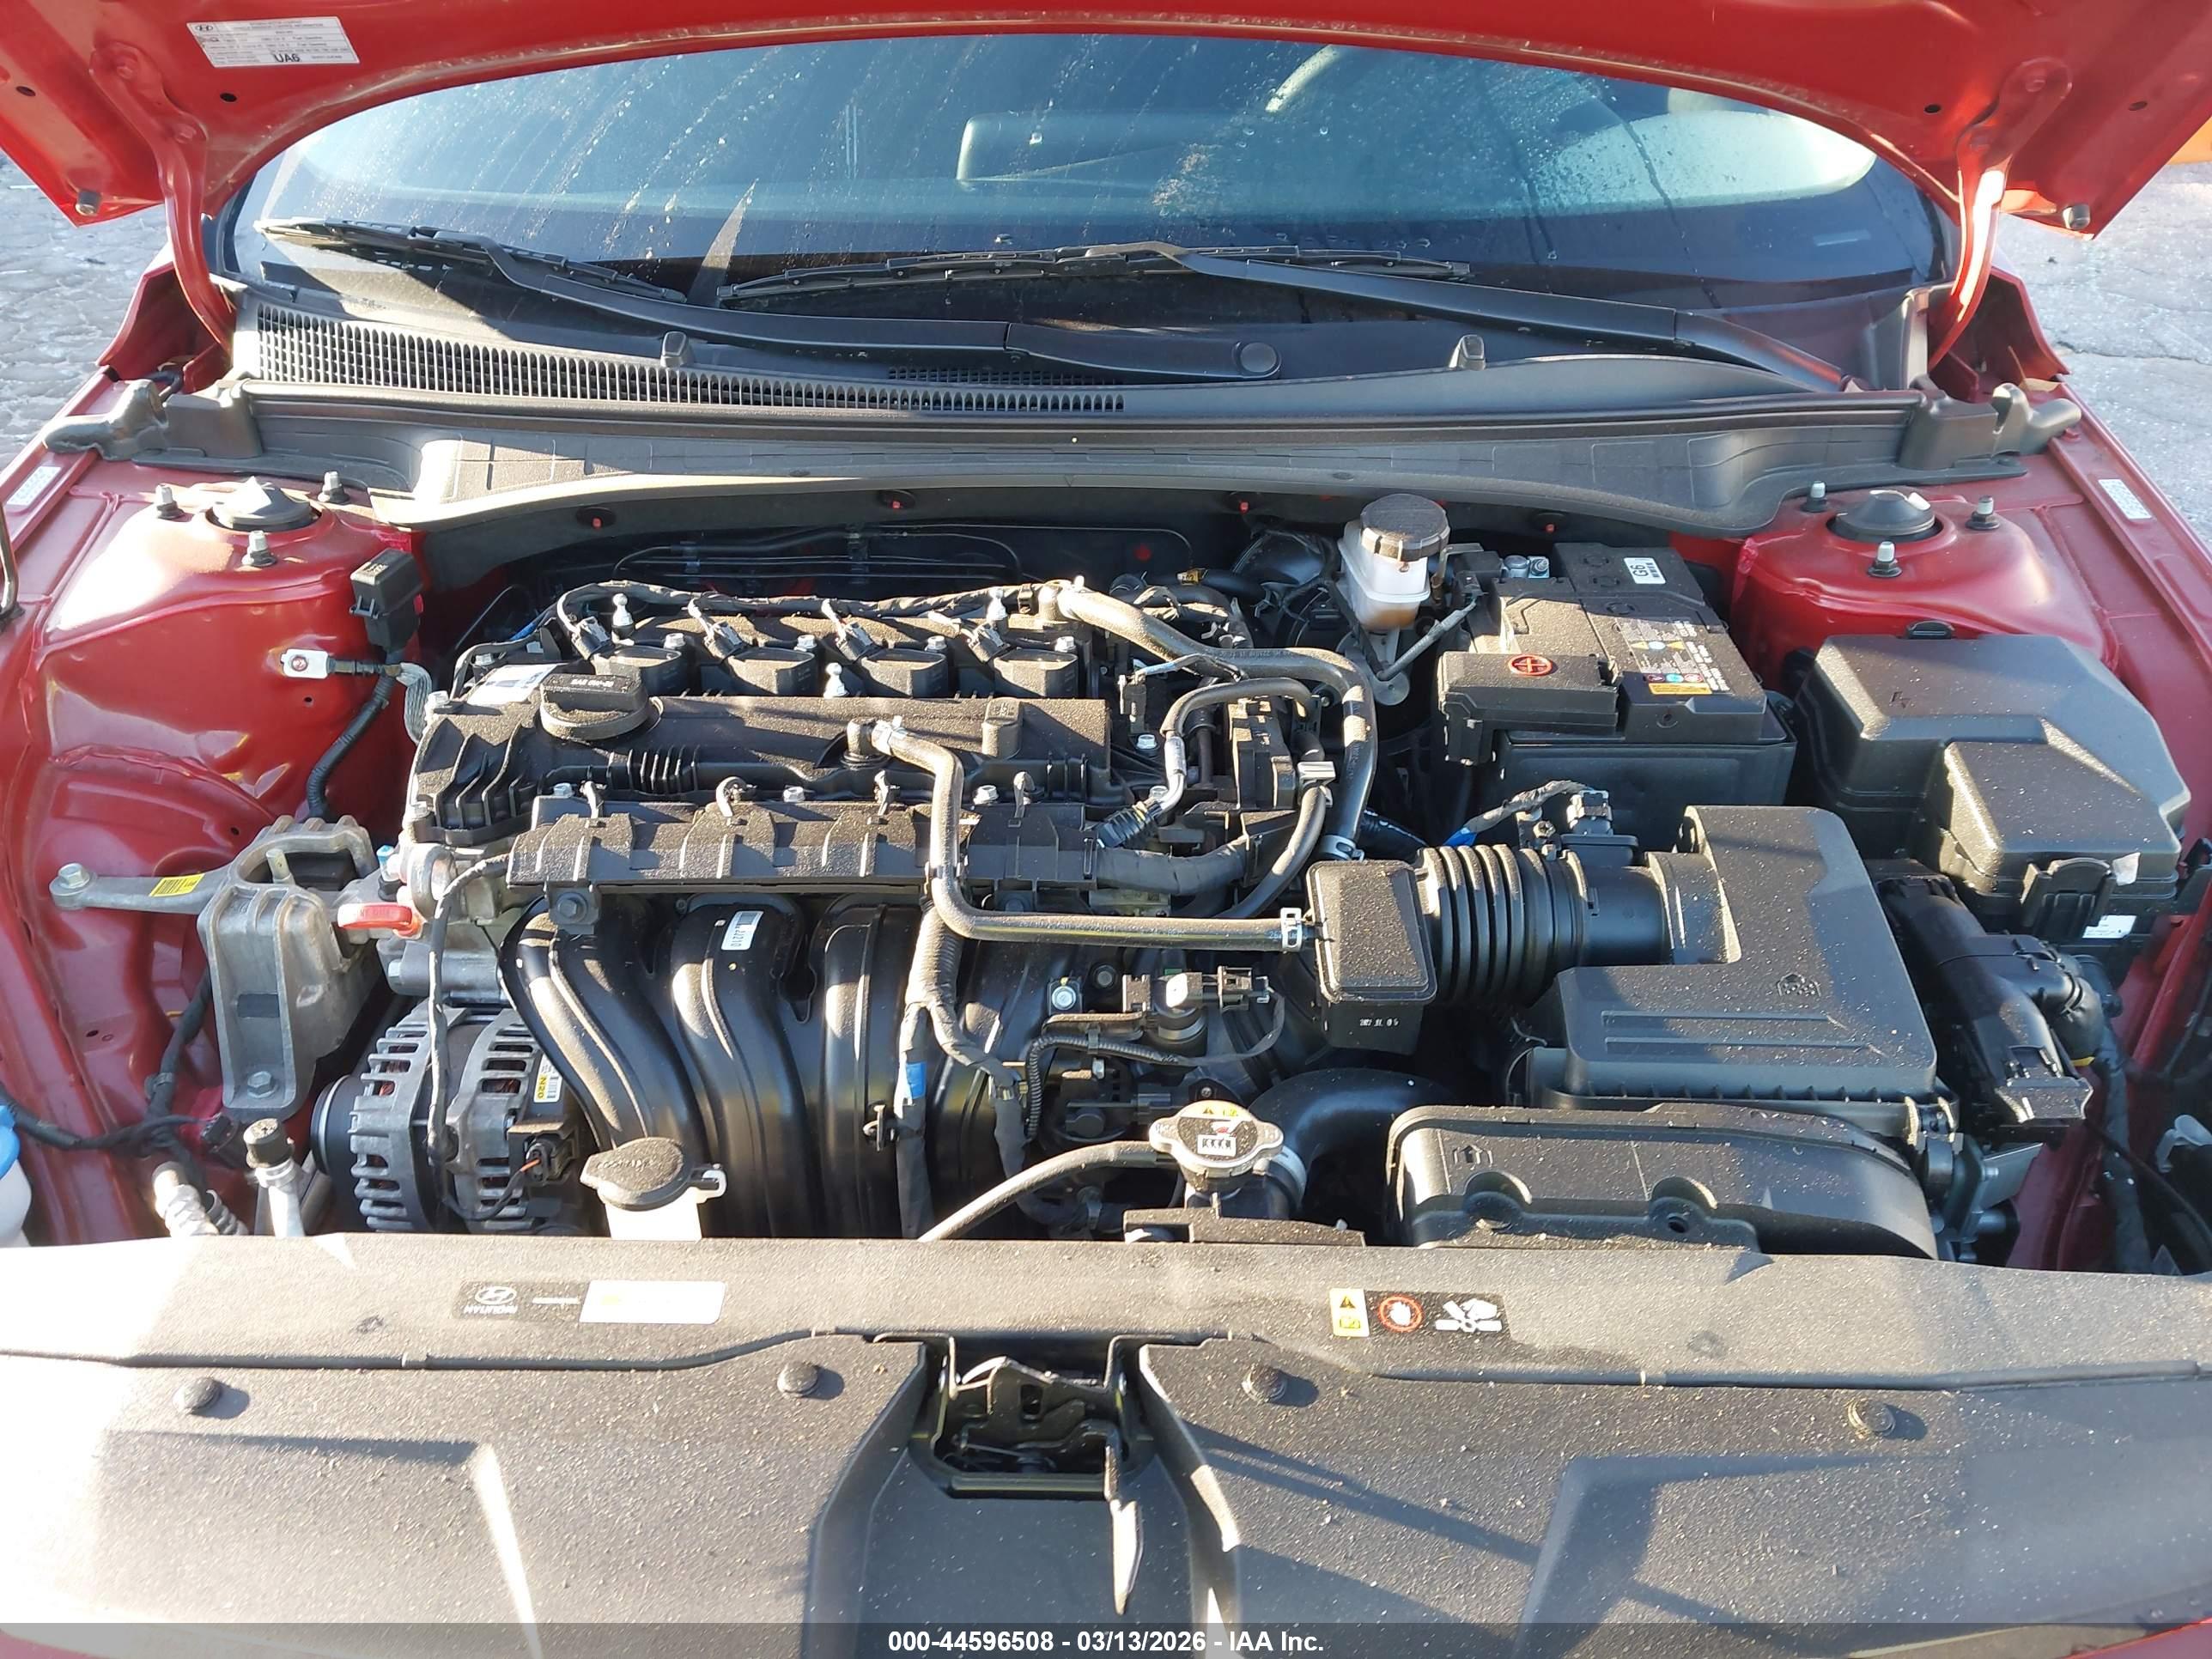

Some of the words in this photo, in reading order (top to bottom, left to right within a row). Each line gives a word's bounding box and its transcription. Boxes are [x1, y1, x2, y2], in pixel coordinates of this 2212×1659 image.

[274, 52, 301, 64] UA6
[1629, 564, 1650, 577] G6
[463, 1304, 519, 1316] HYUNDAI
